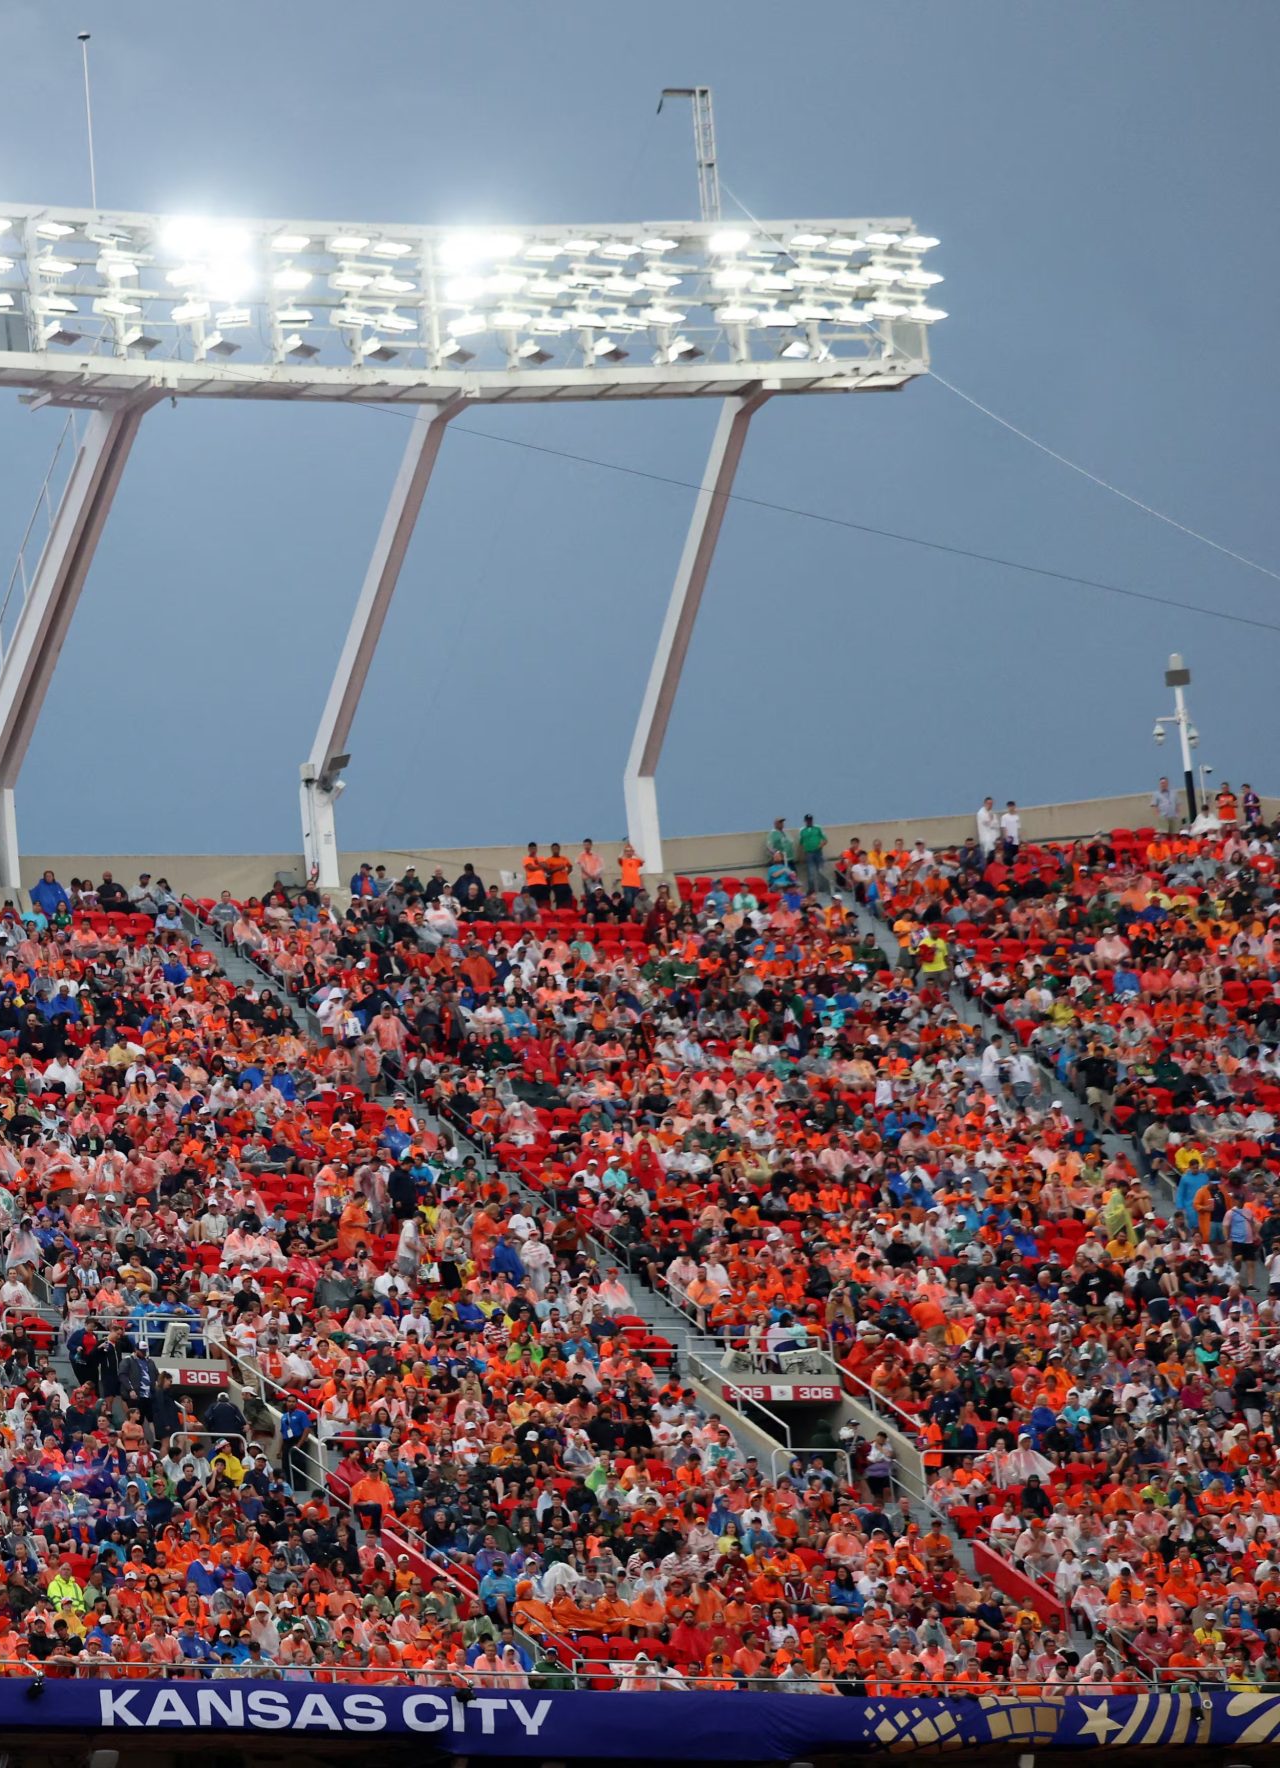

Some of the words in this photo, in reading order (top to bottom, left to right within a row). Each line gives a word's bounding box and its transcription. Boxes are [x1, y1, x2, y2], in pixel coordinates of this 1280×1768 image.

[186, 1371, 221, 1385] 305
[729, 1387, 765, 1399] 305
[799, 1387, 834, 1399] 306
[99, 1689, 387, 1732] KANSAS
[402, 1694, 552, 1735] CITY
